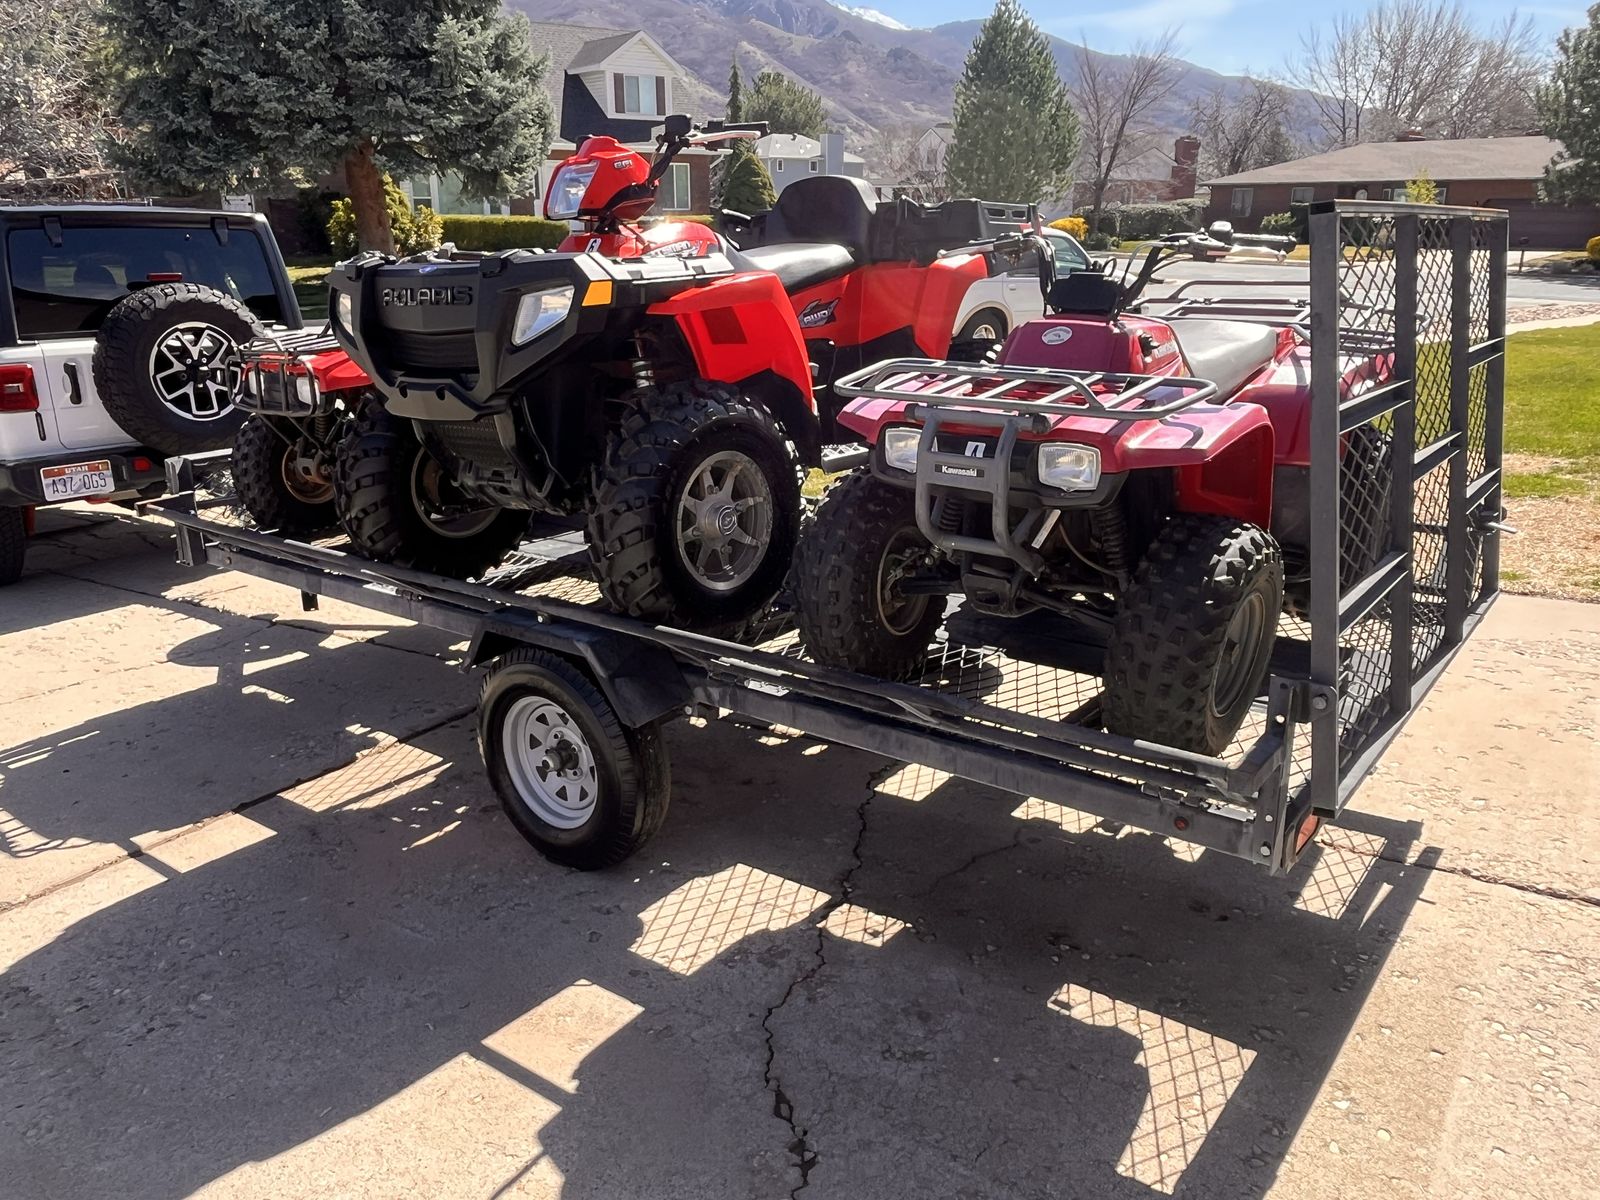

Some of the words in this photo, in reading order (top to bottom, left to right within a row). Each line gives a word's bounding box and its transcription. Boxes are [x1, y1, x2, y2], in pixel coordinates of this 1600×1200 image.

[382, 286, 473, 307] POLARIS
[65, 465, 89, 474] UTAH
[941, 465, 977, 477] Kawasaki
[52, 476, 74, 495] A37
